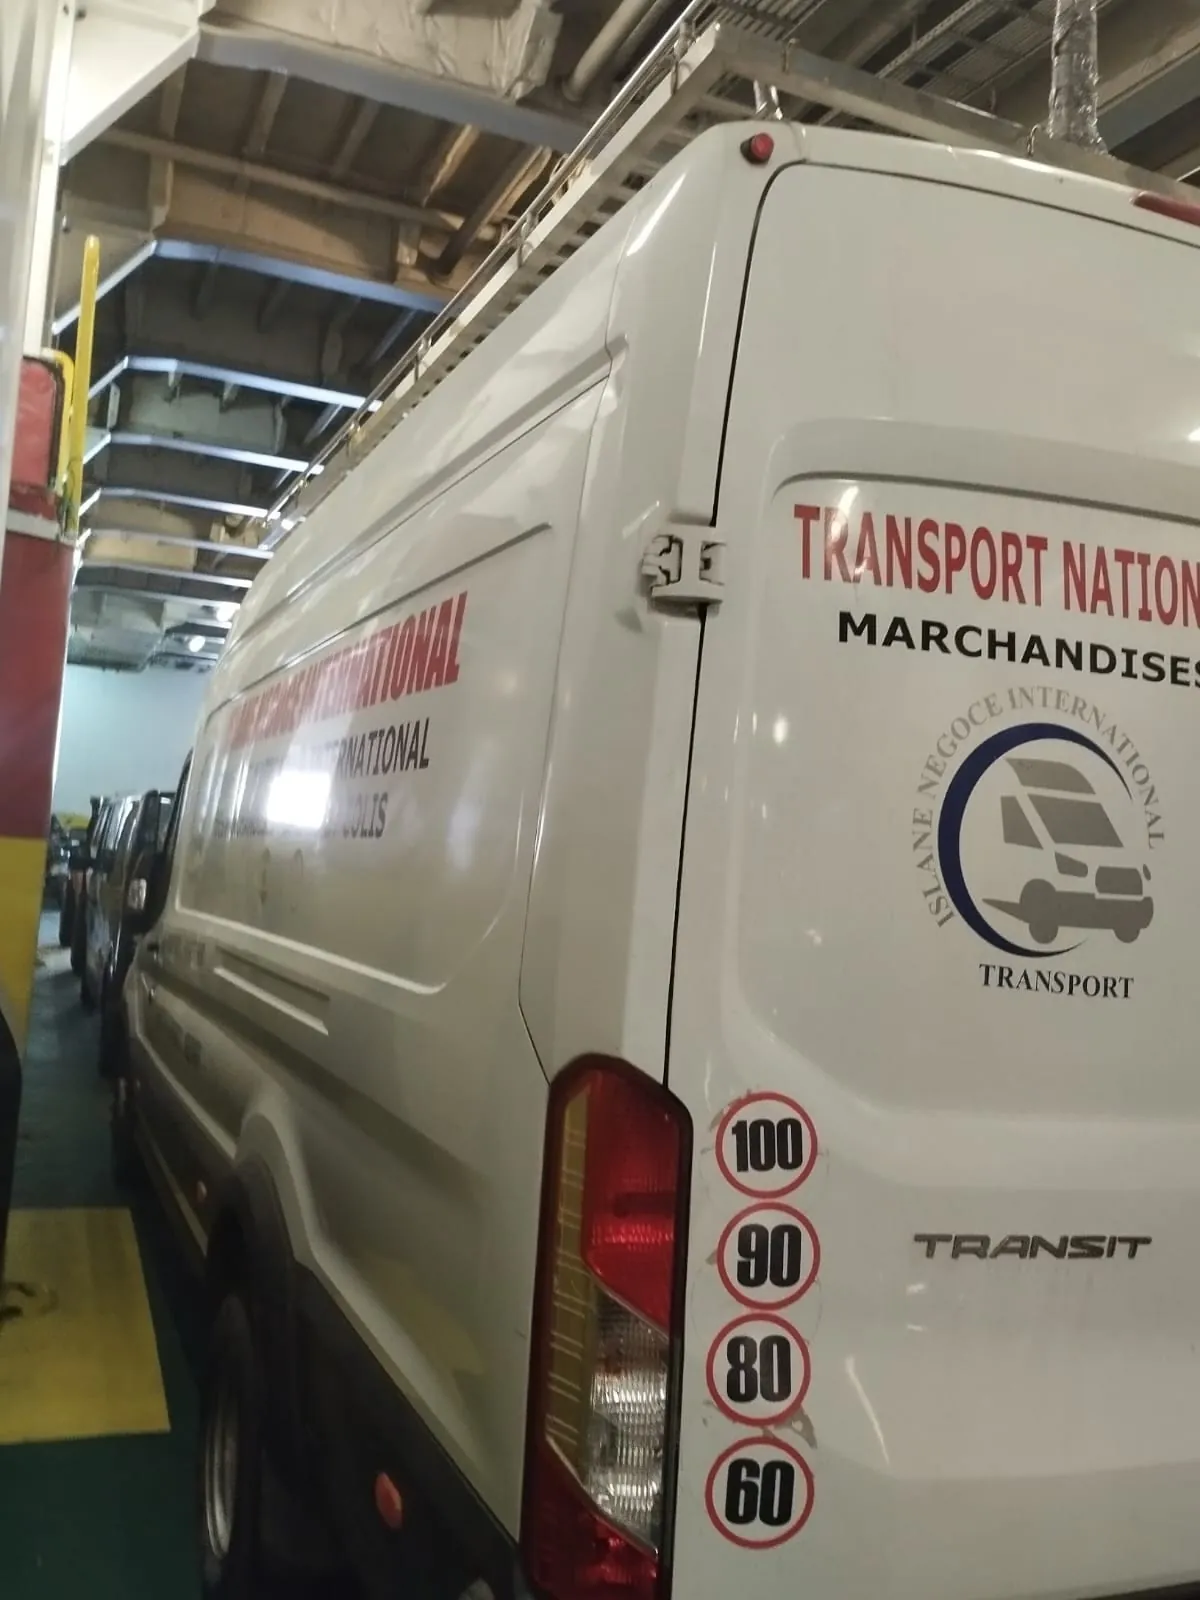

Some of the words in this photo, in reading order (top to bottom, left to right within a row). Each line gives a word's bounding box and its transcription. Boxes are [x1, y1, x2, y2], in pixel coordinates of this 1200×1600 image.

[794, 503, 1048, 607] TRANSPORT
[838, 611, 1200, 689] MARCHANDISE
[917, 691, 1003, 799] NEGOCE
[1007, 685, 1165, 849] INTERNATIONAL
[913, 807, 955, 927] ISLANE
[979, 963, 1134, 999] TRANSPORT
[731, 1117, 803, 1172] 100
[736, 1223, 802, 1287] 90
[914, 1233, 1153, 1260] TRANSIT
[726, 1335, 792, 1402] 80
[725, 1458, 795, 1526] 60
